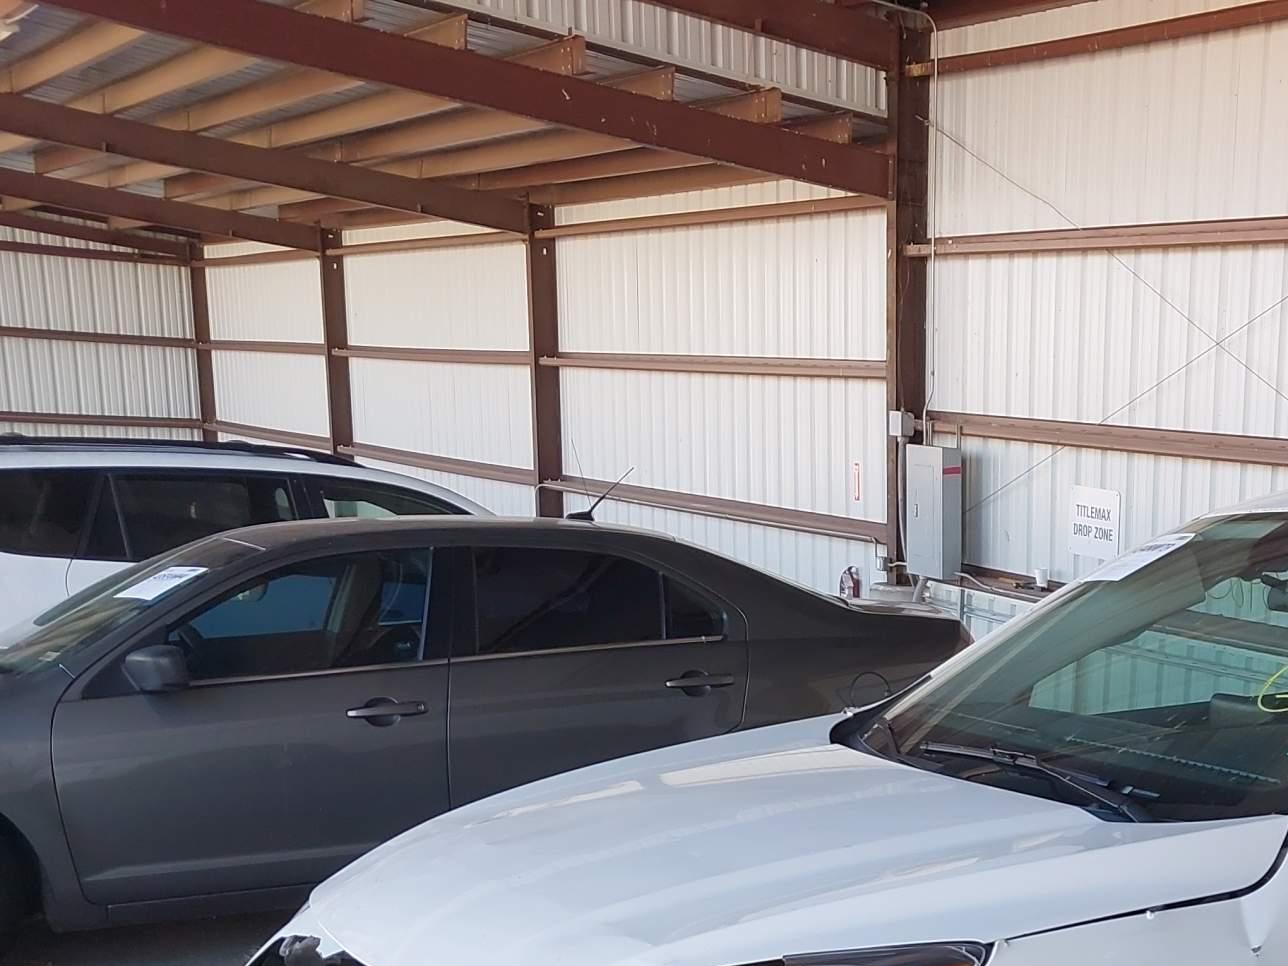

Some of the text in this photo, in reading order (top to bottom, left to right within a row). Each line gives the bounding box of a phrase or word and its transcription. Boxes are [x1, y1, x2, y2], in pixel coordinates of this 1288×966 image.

[1076, 504, 1112, 521] TITLEMAX
[1073, 523, 1113, 542] DROP ZONE
